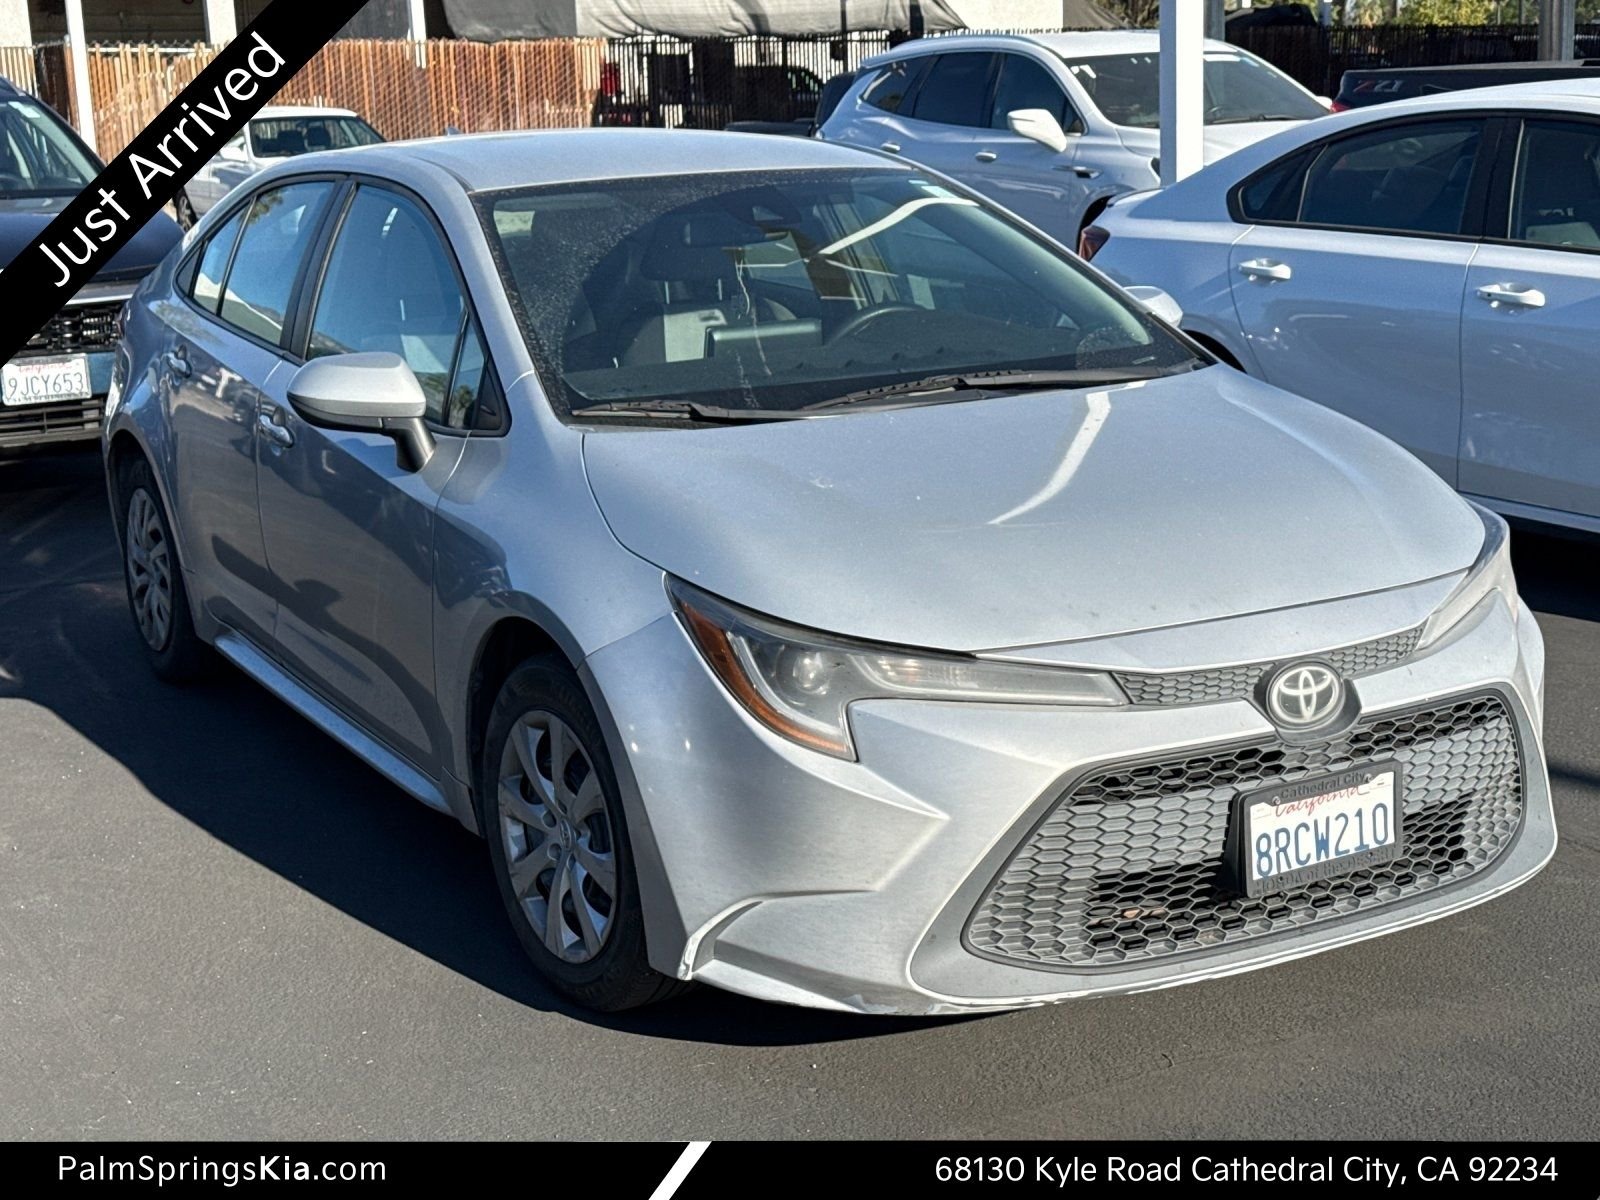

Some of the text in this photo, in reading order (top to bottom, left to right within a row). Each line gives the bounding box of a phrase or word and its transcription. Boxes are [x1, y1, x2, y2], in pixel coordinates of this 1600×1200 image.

[8, 371, 84, 399] 9JCY653
[1280, 771, 1366, 799] Cathedral City
[1275, 786, 1370, 817] California
[1255, 802, 1389, 877] 8RCW210
